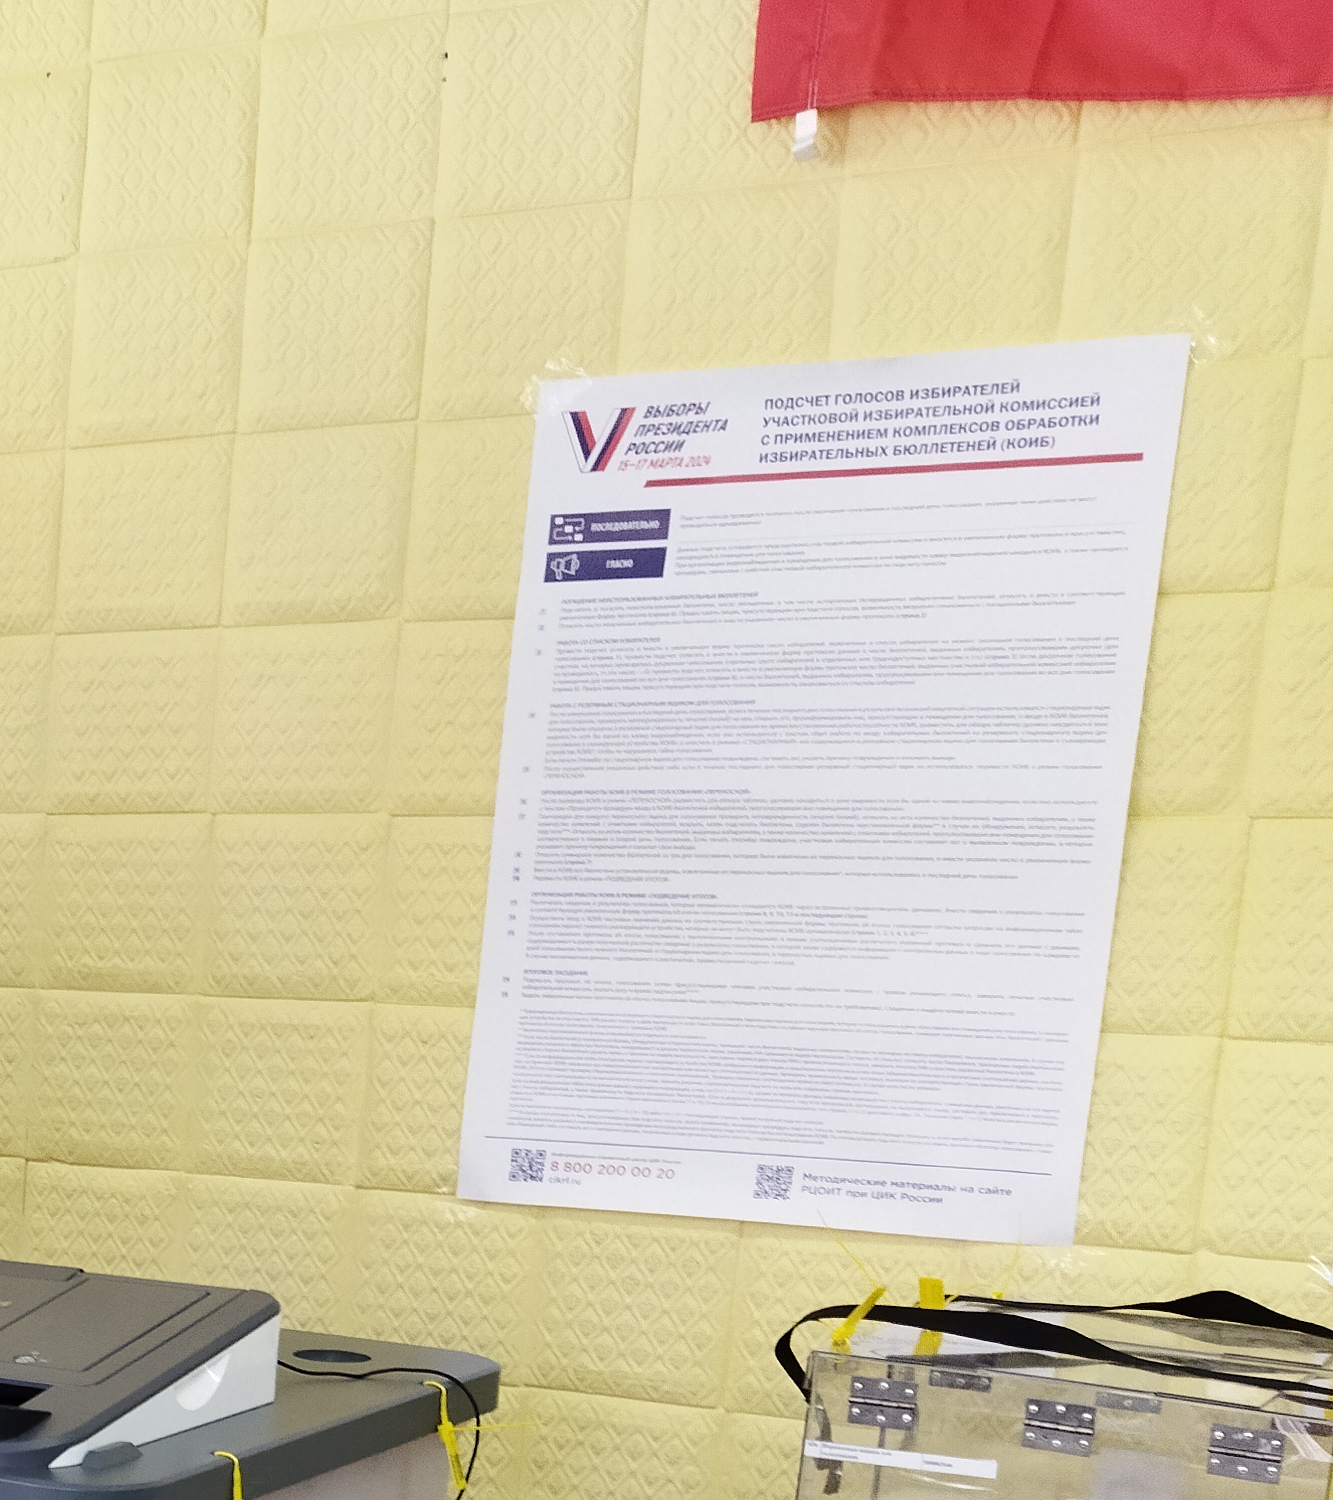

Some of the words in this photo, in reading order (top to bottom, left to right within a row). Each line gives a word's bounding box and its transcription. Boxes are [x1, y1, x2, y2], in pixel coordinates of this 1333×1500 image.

[764, 394, 831, 411] ПОДСЧЕТ
[834, 389, 905, 406] ГОЛОСОВ
[909, 378, 1021, 400] ИЗБИРАТЕЛЕЙ
[642, 401, 711, 419] ВЫБОРЫ
[762, 408, 859, 428] УЧАСТКОВОЙ
[862, 399, 995, 423] ИЗБИРАТЕЛЬНОЙ
[999, 391, 1101, 413] КОМИССИЕЙ
[633, 418, 729, 438] ПРЕЗИДЕНТА
[760, 434, 771, 446] С
[773, 427, 889, 446] ПРИМЕНЕНИЕМ
[891, 420, 1001, 439] КОМПЛЕКСОВ
[1004, 414, 1101, 432] ОБРАБОТКИ
[624, 439, 686, 456] РОССИИ
[758, 445, 890, 464] ИЗБИРАТЕЛЬНЫХ
[892, 435, 998, 457] БЮЛЛЕТЕНЕЙ
[1000, 435, 1056, 453] (КОИБ)
[550, 1161, 560, 1172] 8
[563, 1161, 593, 1174] 800
[597, 1164, 627, 1176] 200
[630, 1166, 652, 1179] 00
[656, 1168, 676, 1180] 20
[802, 1172, 887, 1188] Методические
[890, 1180, 957, 1193] материалы
[978, 1185, 1013, 1197] сайте
